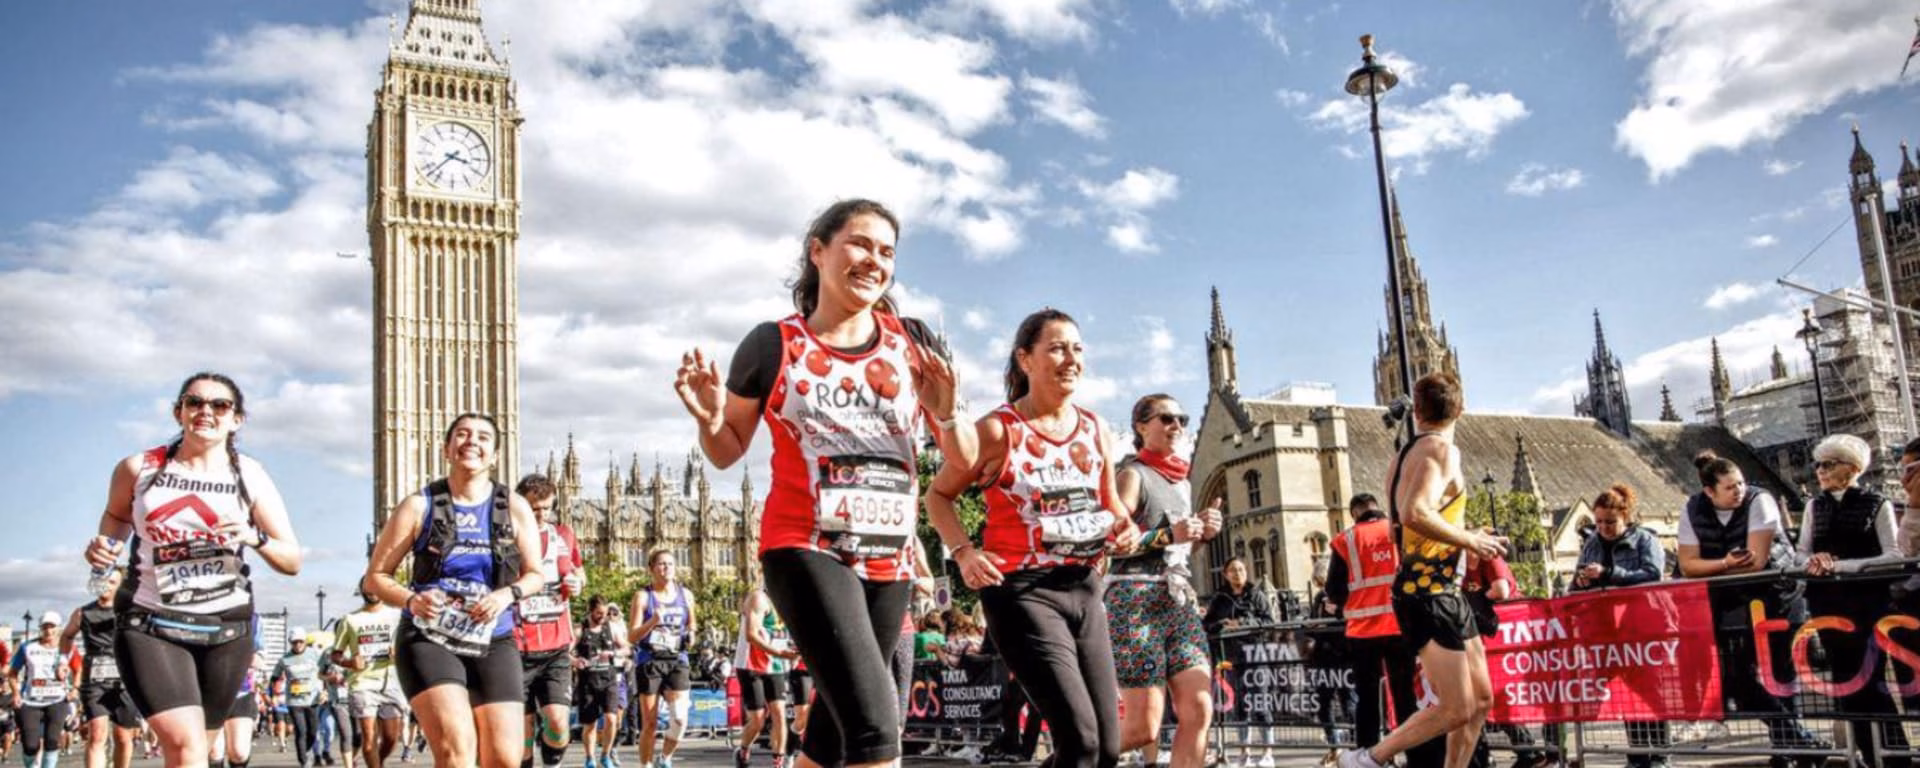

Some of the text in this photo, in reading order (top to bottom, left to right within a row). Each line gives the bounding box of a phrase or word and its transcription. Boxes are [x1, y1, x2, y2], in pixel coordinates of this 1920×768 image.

[154, 473, 237, 494] Shannon
[829, 461, 865, 484] tcs
[834, 495, 904, 526] 46955
[1372, 550, 1391, 562] 804
[168, 560, 225, 585] 19162
[1498, 617, 1568, 644] TATA
[1242, 642, 1299, 663] TATA
[1502, 639, 1680, 676] CONSULTANCY
[1750, 599, 1920, 697] tcs
[941, 669, 968, 683] TATA
[1243, 667, 1356, 690] CONSULTANC
[908, 681, 940, 718] cs
[943, 684, 1002, 701] CONSULTANCY
[1244, 692, 1321, 713] SERVICES
[1504, 677, 1612, 705] SERVICES
[944, 703, 981, 719] SERVICES
